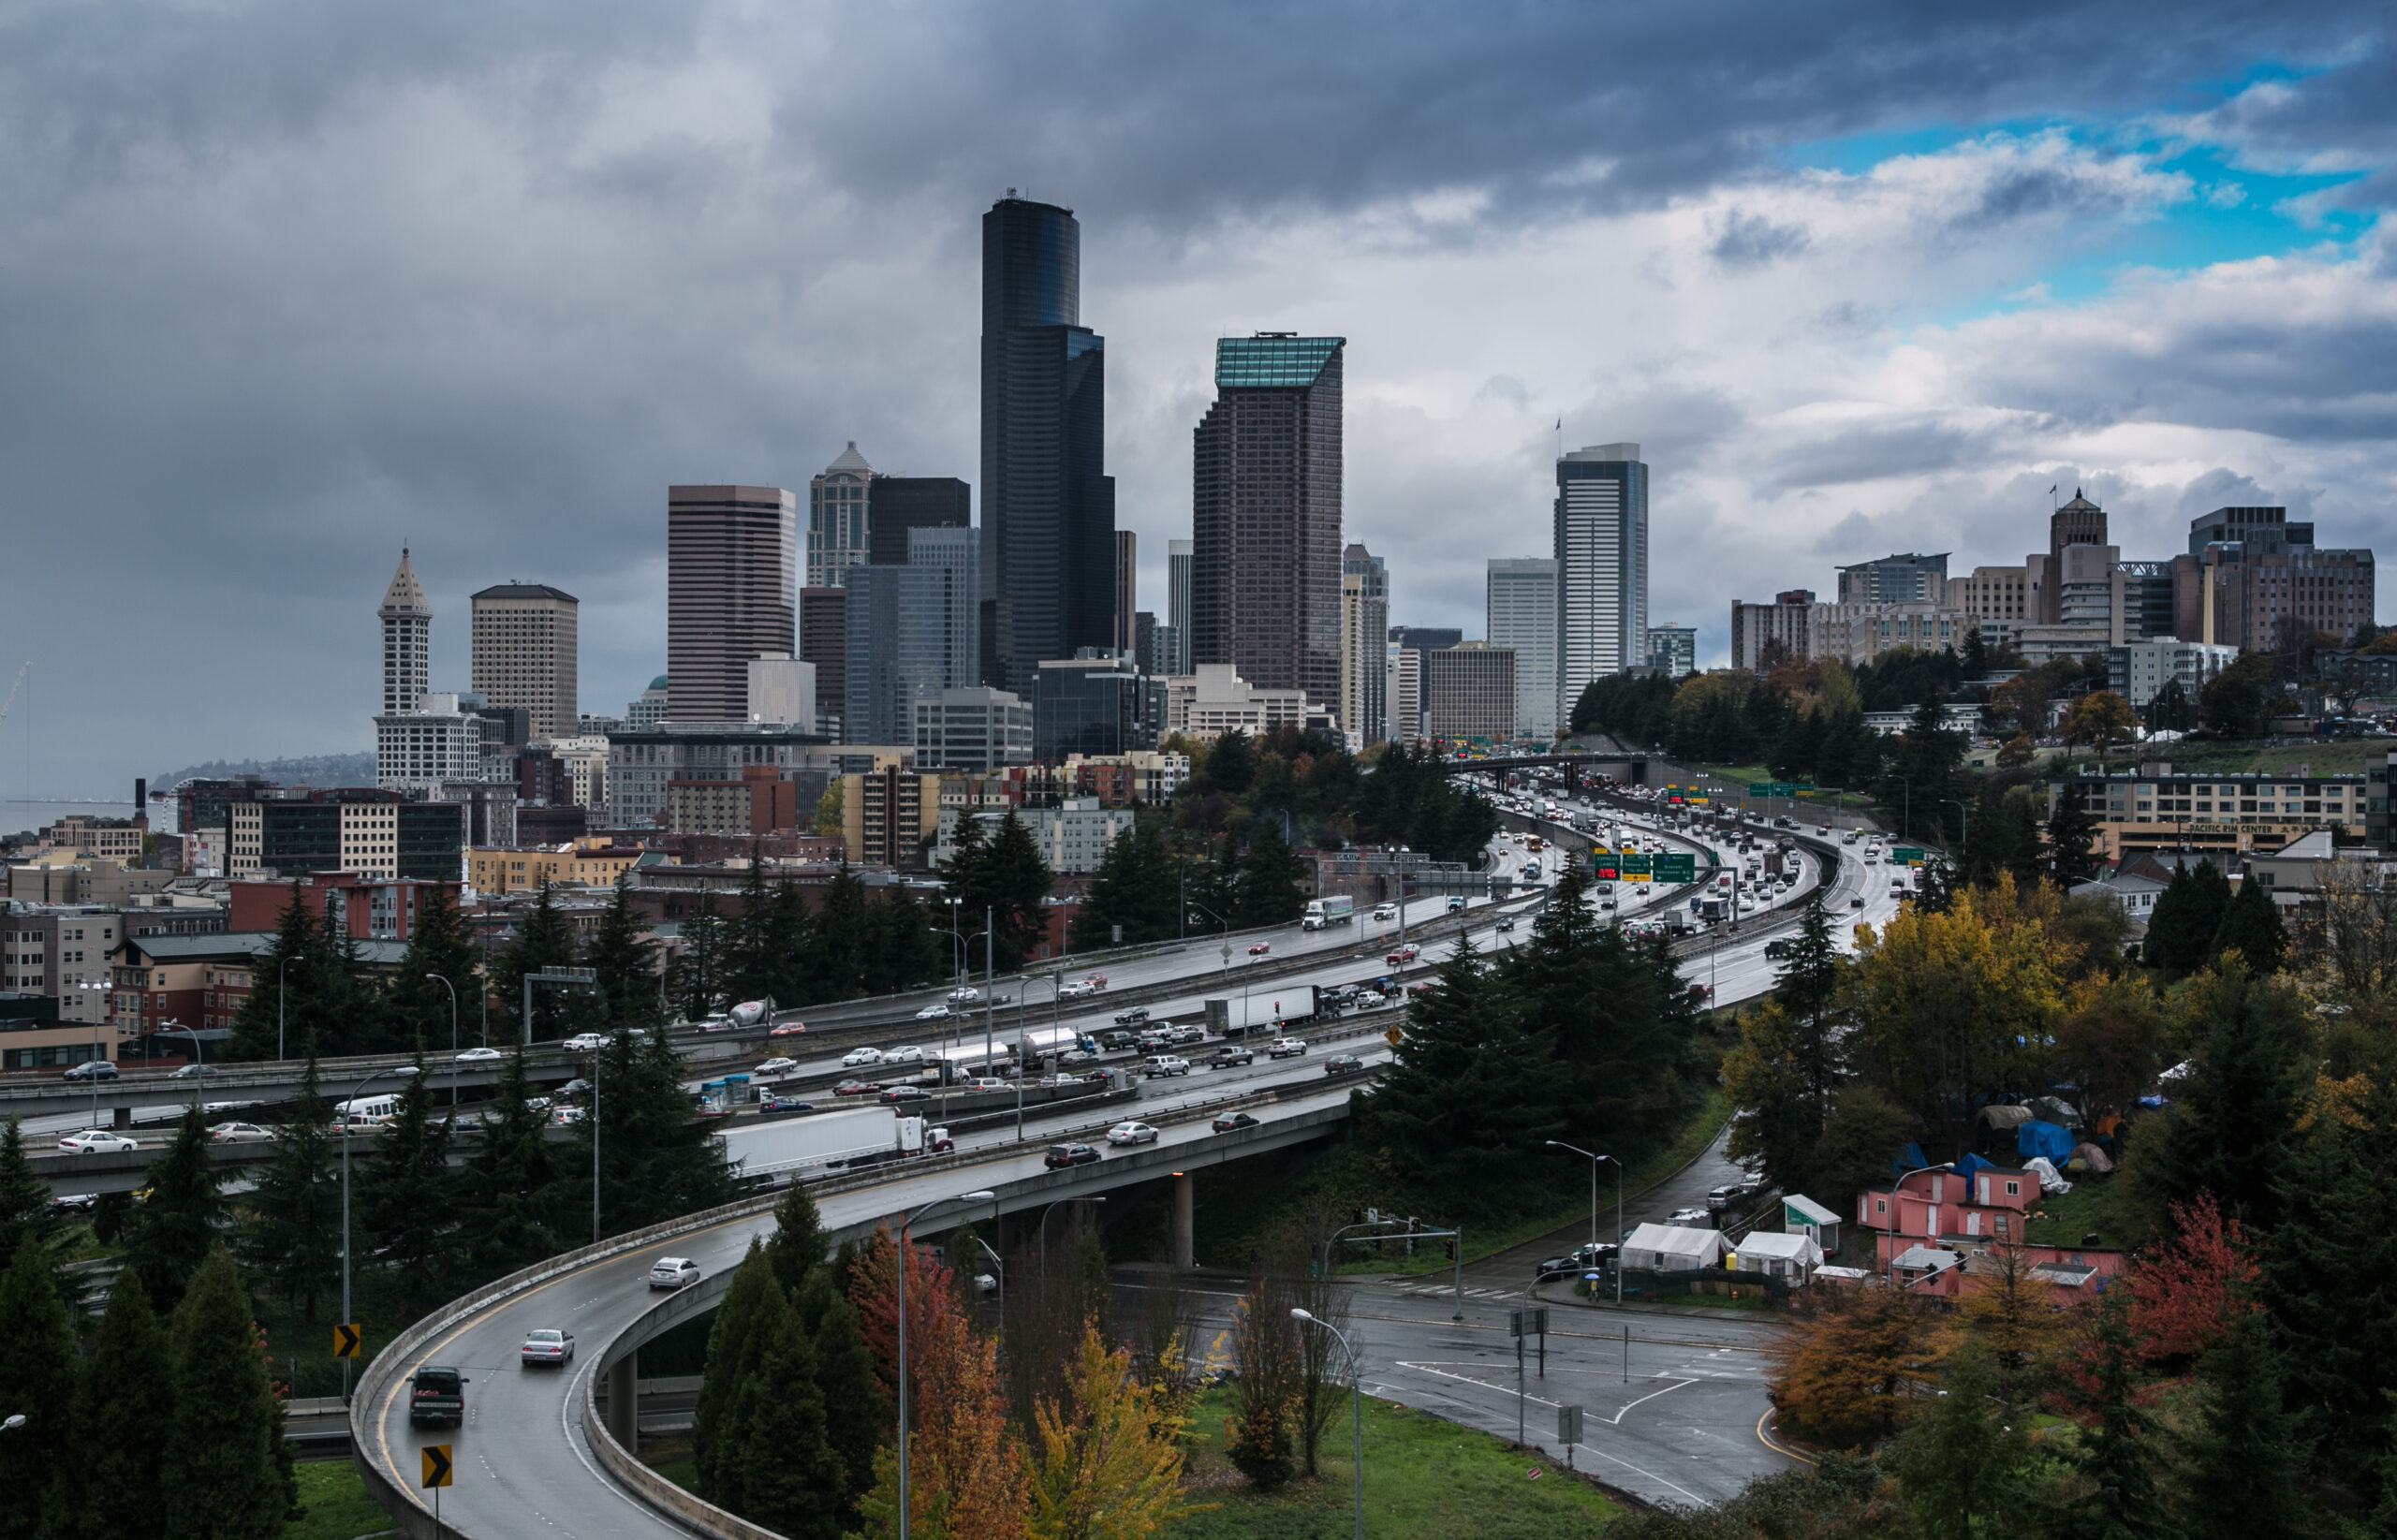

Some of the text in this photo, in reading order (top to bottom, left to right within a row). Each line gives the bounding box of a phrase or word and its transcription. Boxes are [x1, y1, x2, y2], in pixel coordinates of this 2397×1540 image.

[2189, 825, 2272, 833] PACIFIC RIM CENTER
